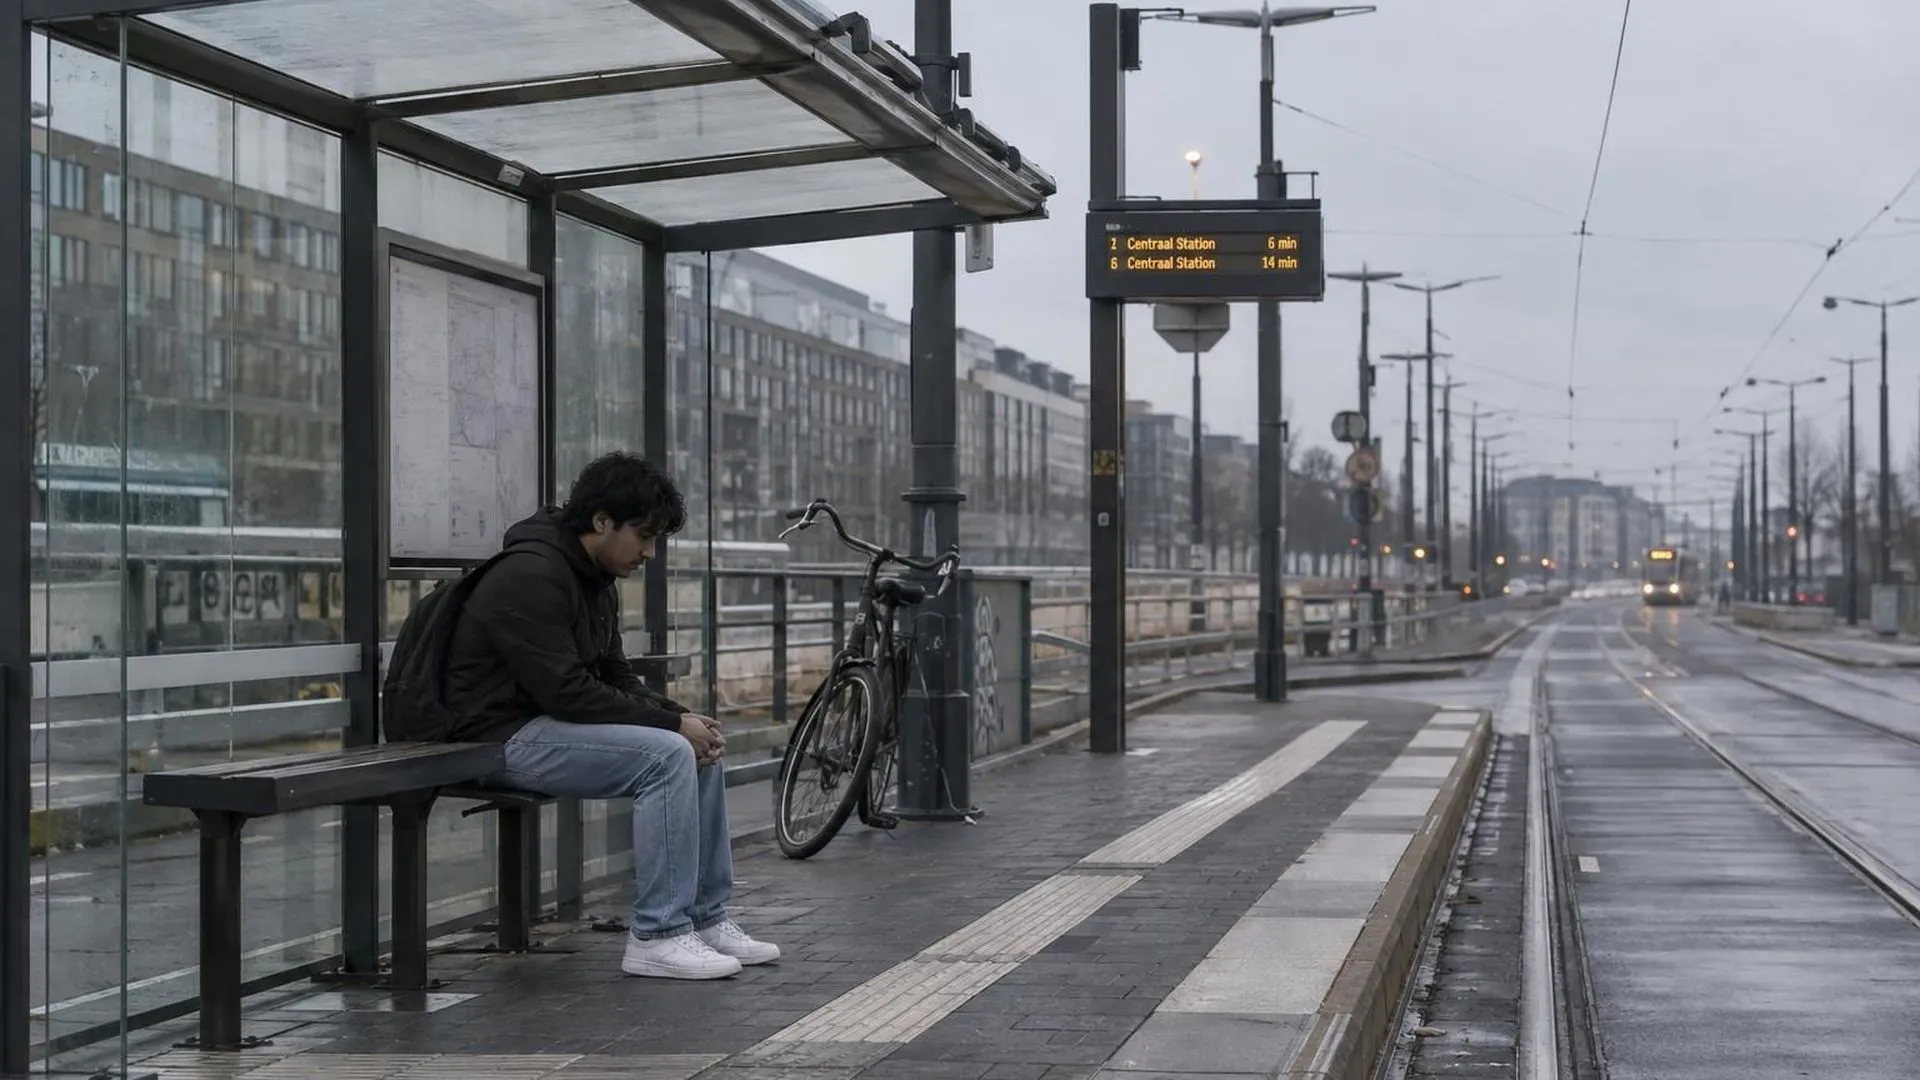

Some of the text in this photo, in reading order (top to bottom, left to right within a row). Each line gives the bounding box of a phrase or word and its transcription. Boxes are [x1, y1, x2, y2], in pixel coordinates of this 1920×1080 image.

[1127, 237, 1174, 250] Centraal
[1176, 236, 1216, 250] Station
[1268, 236, 1275, 250] 6
[1278, 236, 1297, 250] min
[1110, 256, 1297, 269] 6 Centraal Station 14 min
